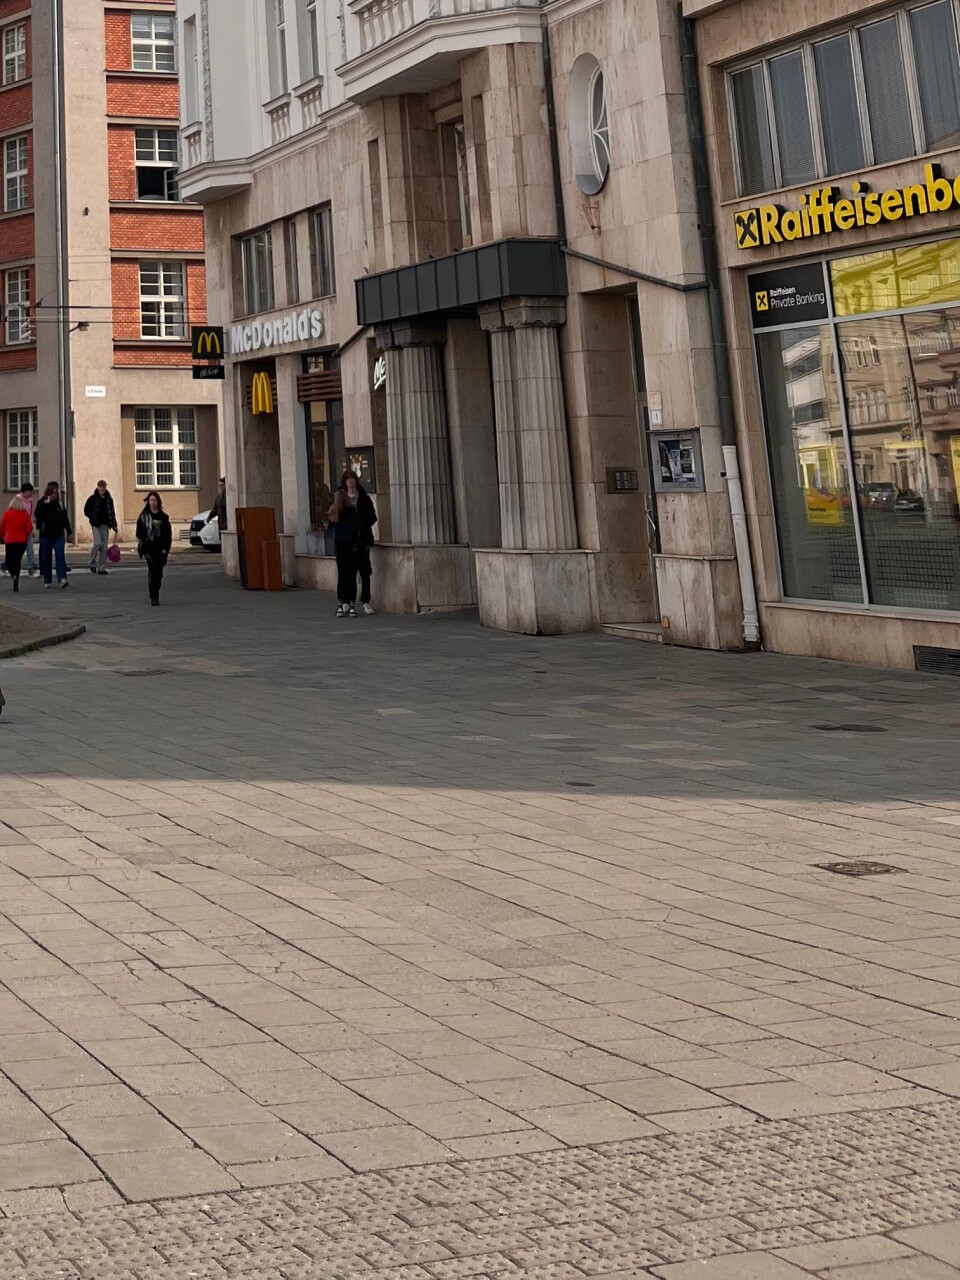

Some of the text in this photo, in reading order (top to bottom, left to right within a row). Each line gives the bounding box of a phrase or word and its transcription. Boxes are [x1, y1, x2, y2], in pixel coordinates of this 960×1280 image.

[769, 286, 796, 297] Raiffeisen
[771, 291, 825, 309] Private Banking
[231, 308, 323, 354] McDonald's
